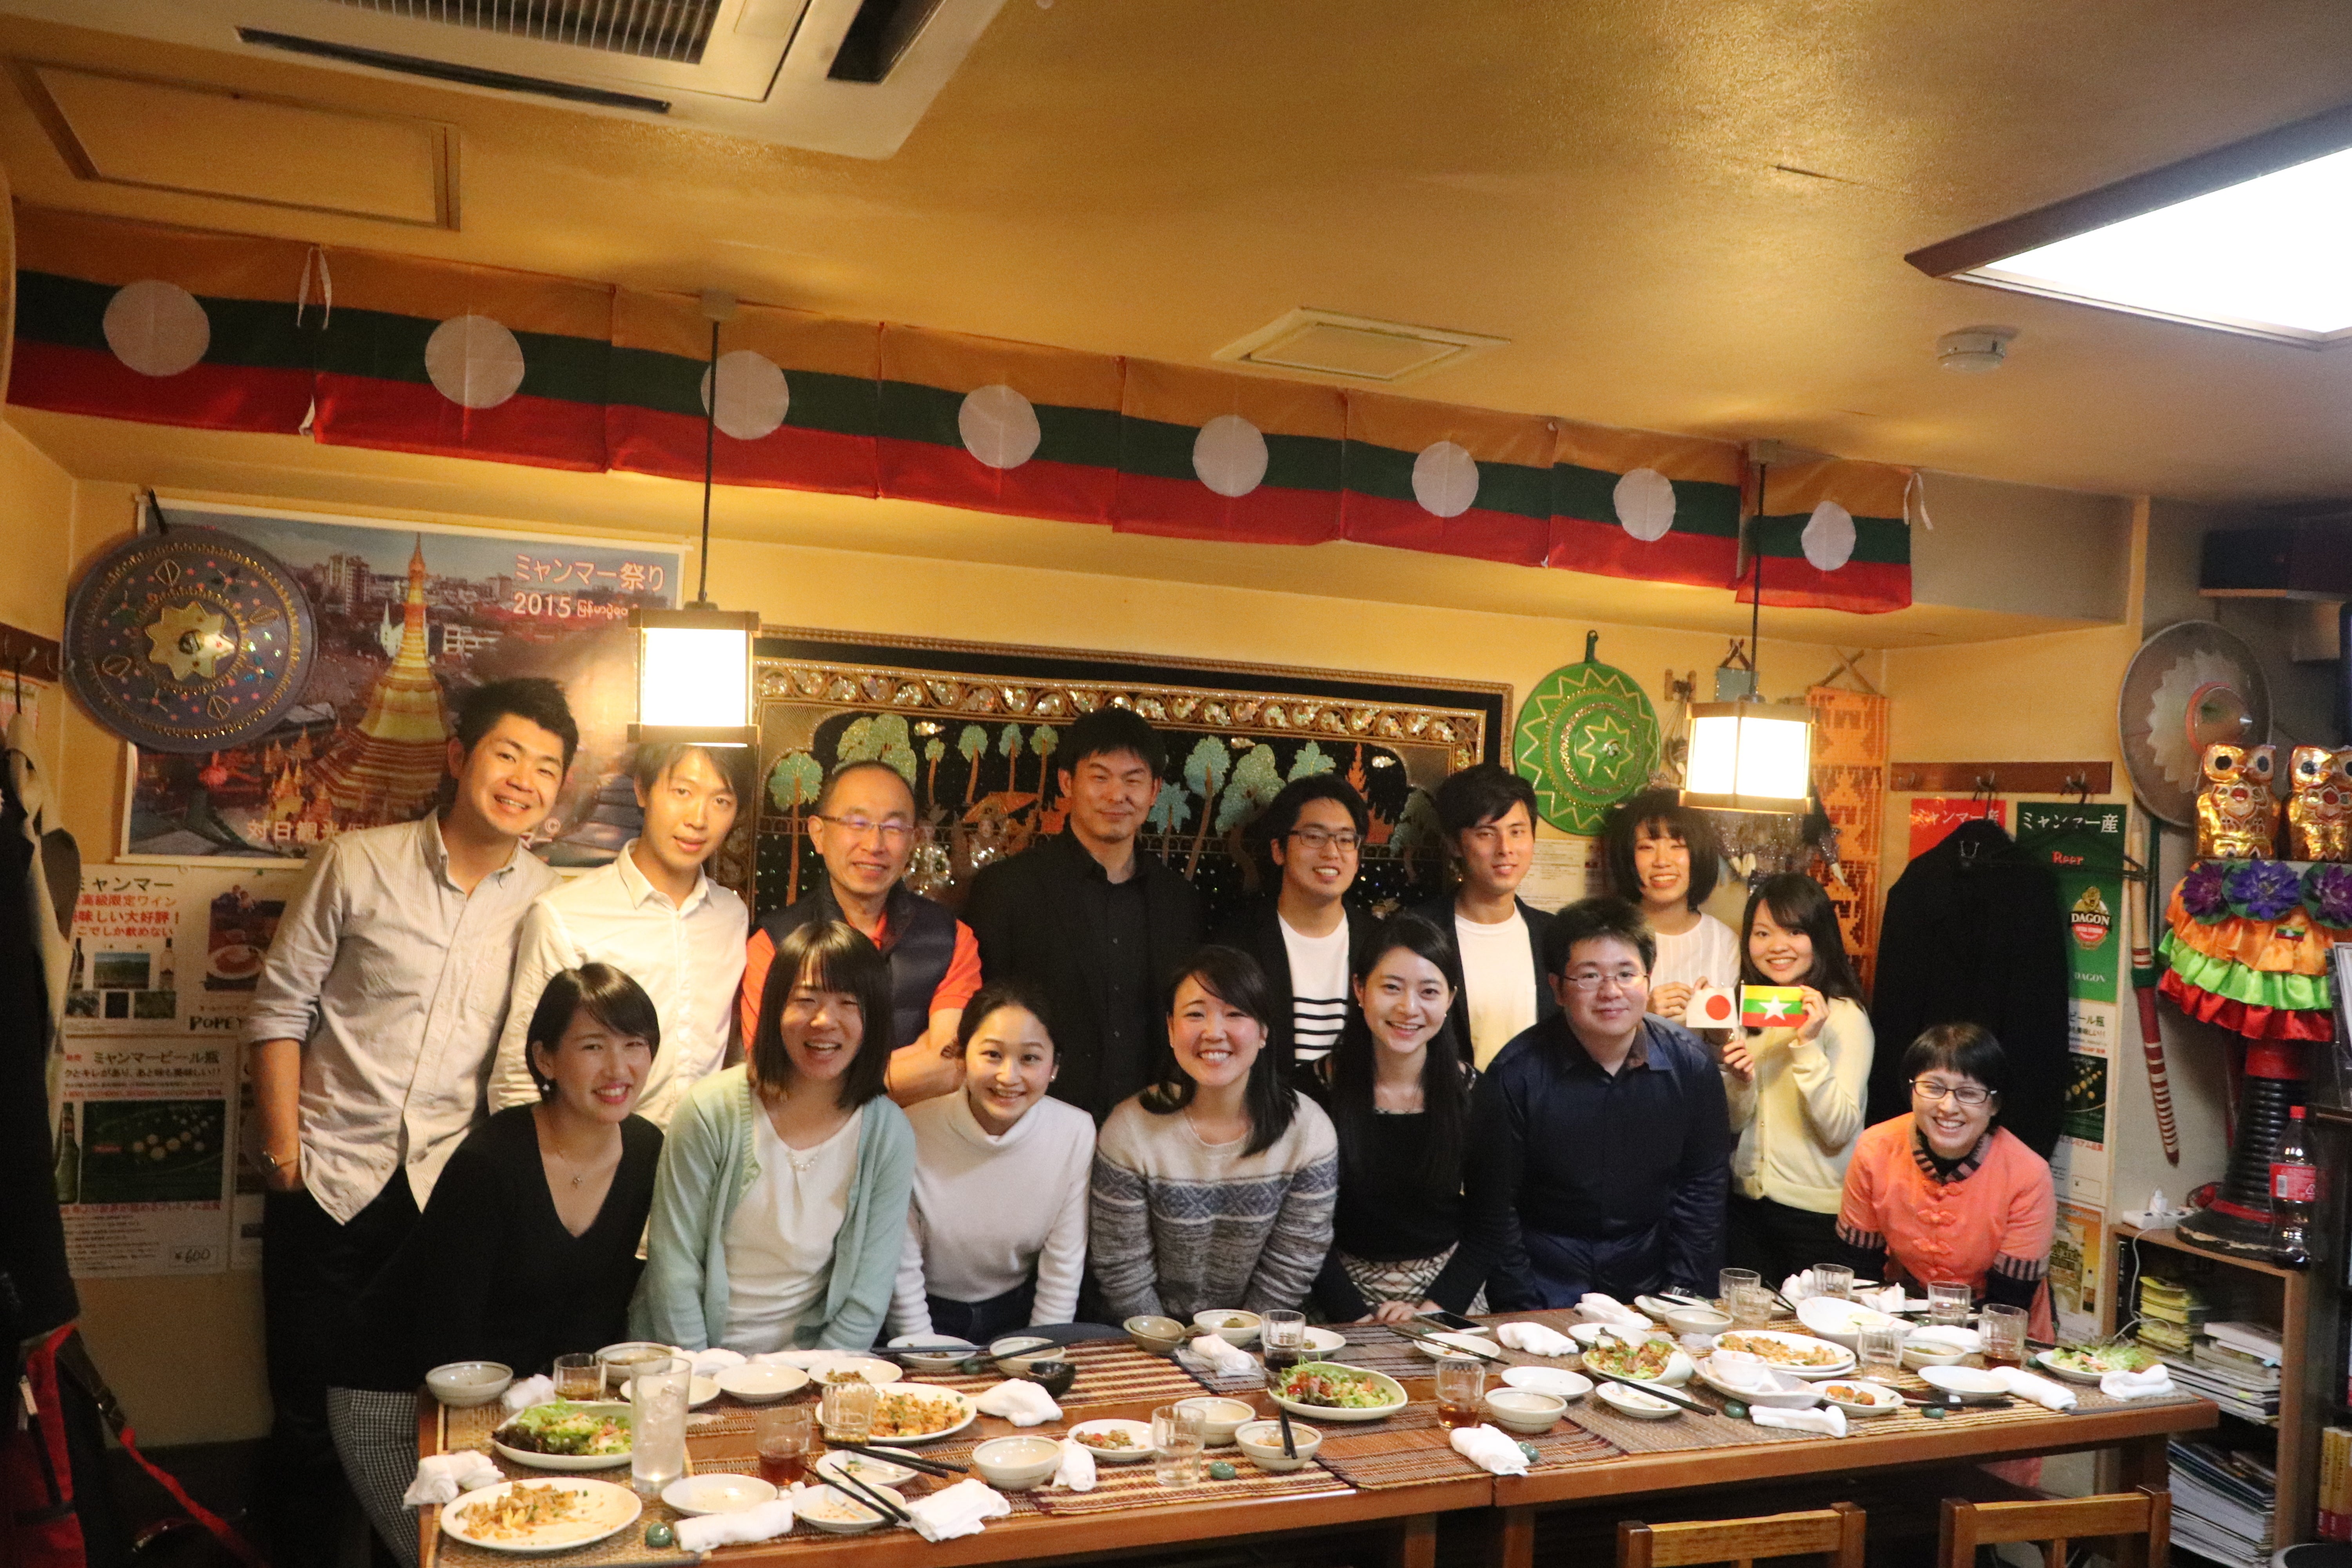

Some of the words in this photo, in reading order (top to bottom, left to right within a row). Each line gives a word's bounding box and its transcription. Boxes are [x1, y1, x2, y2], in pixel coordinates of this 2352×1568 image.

[515, 554, 665, 592] ミャンマー祭り
[513, 591, 571, 619] 2015
[78, 894, 176, 907] 高級限定ワイン
[2071, 913, 2111, 926] DAGON
[2074, 972, 2105, 983] DAGON
